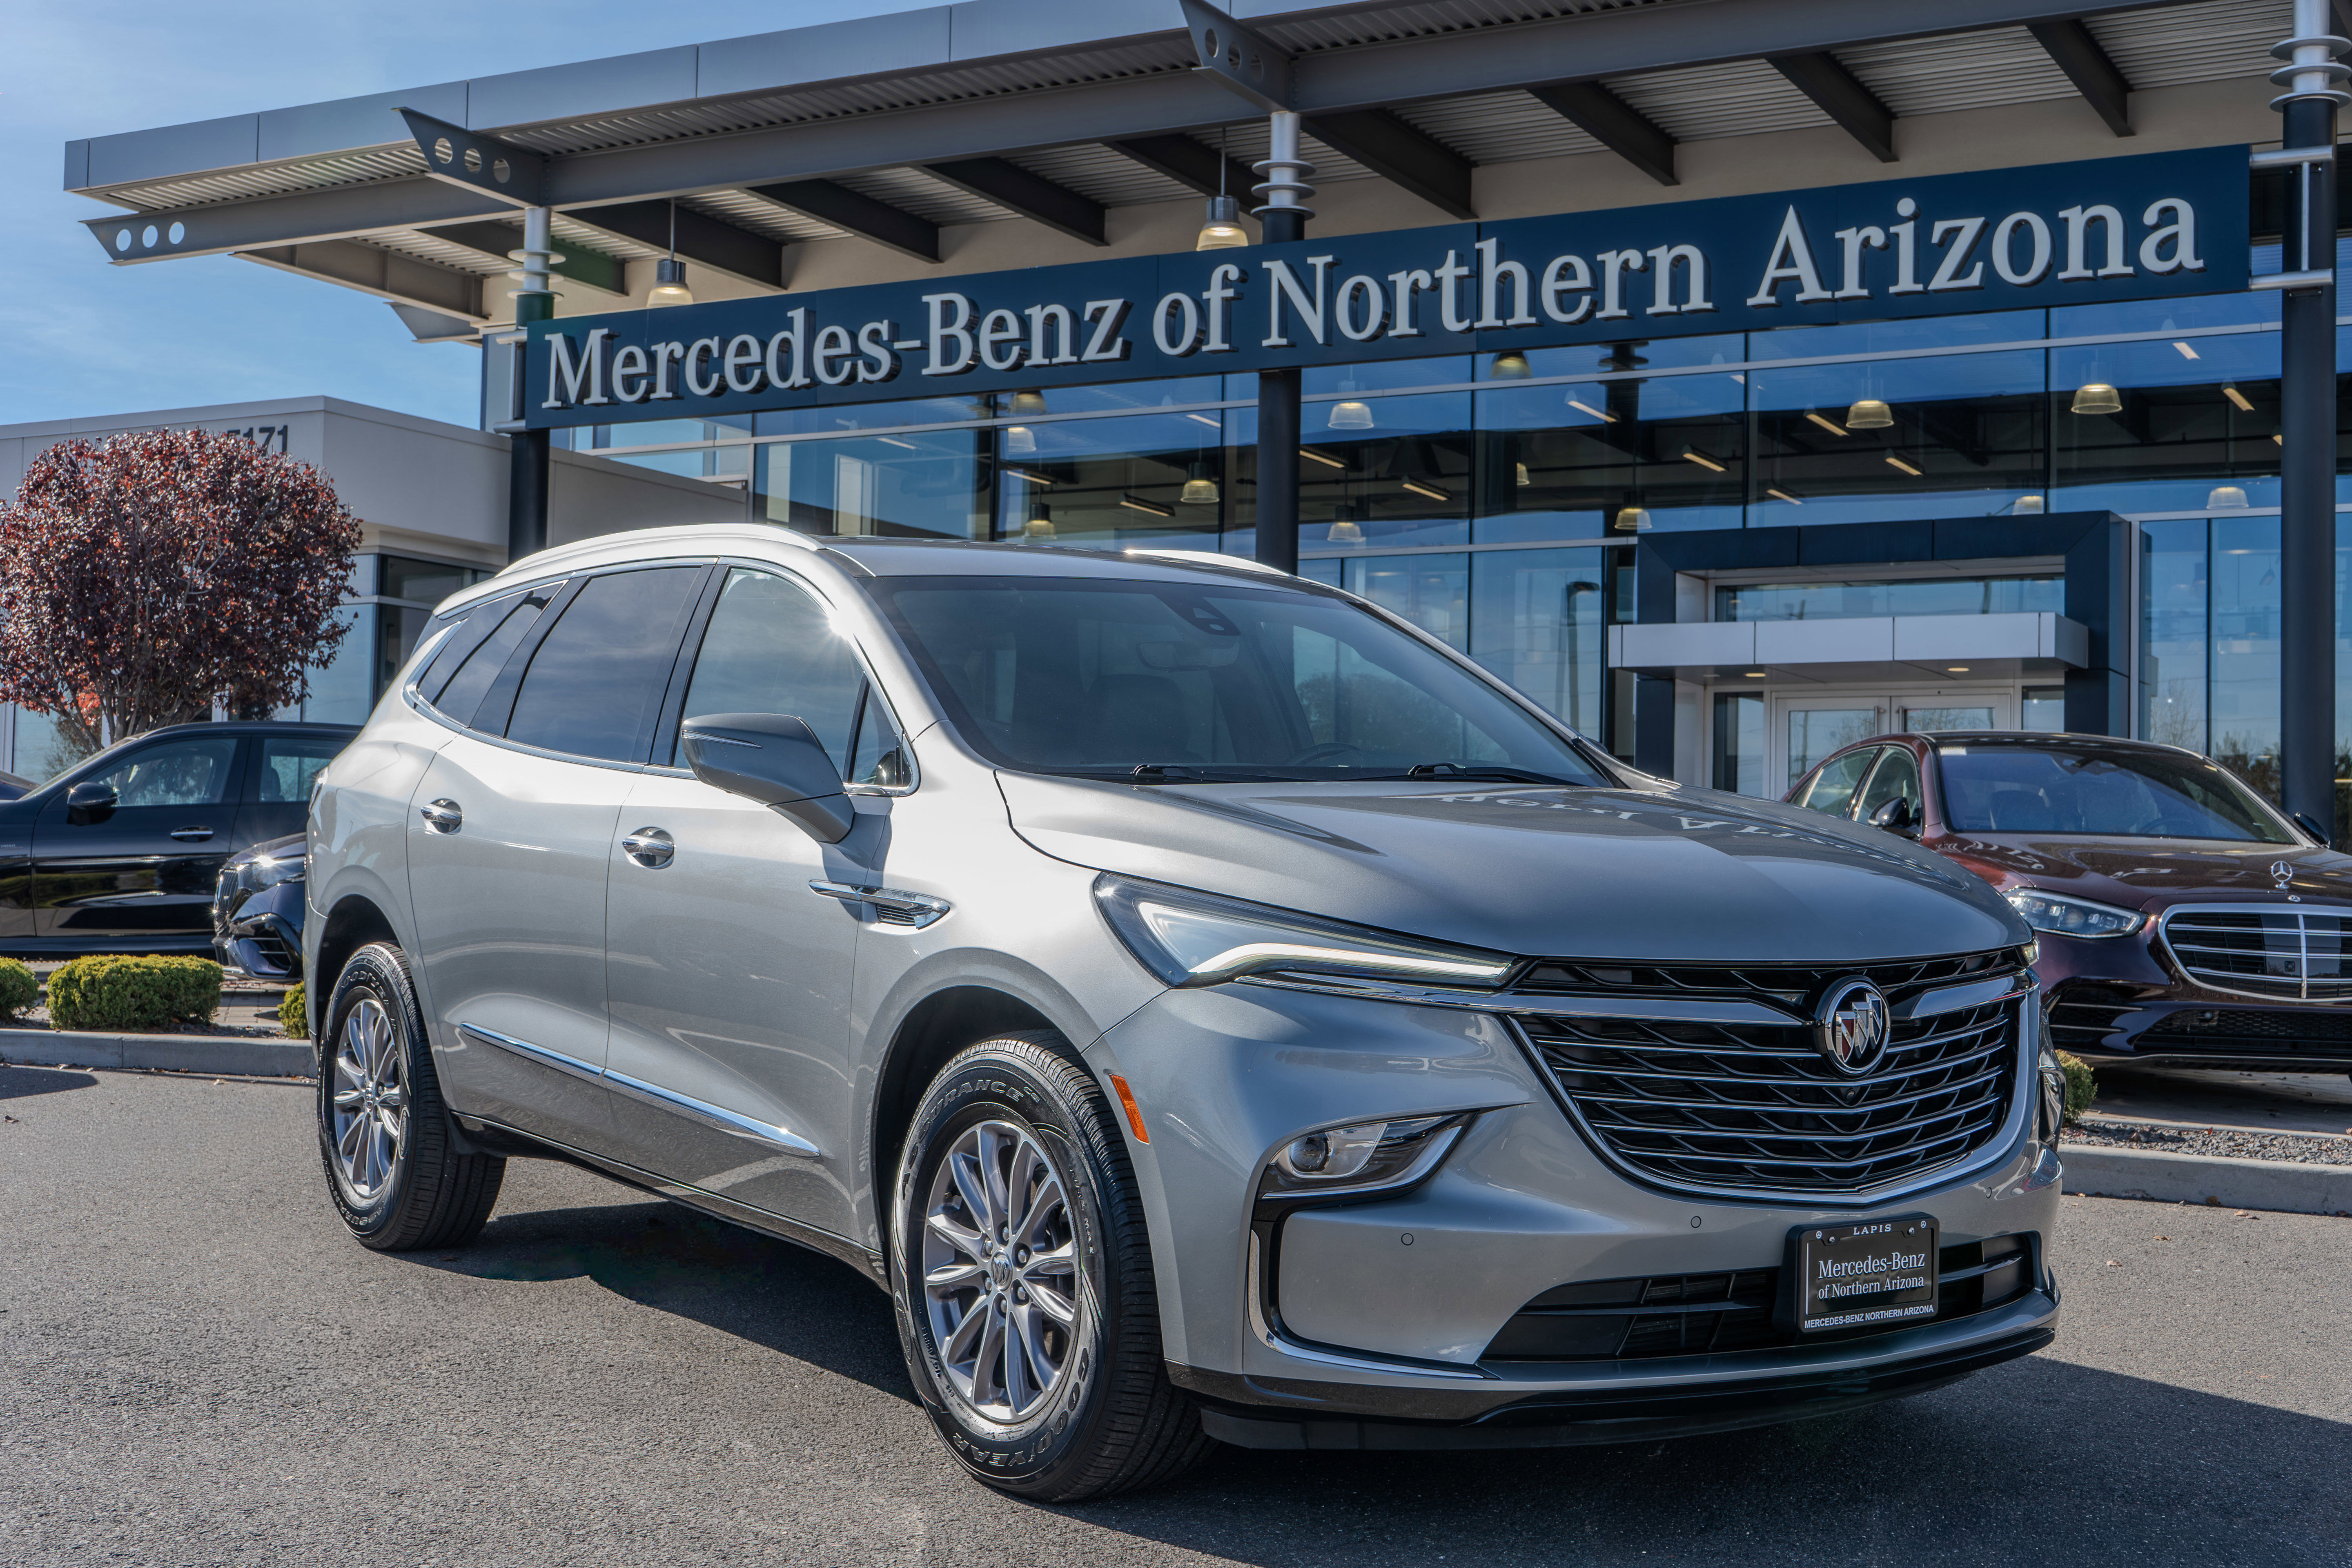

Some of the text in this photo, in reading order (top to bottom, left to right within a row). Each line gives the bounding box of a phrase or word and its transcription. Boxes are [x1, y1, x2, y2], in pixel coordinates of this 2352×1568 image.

[542, 198, 2206, 408] Mercedes-Benz of Northern Arizona
[902, 1079, 1024, 1201] ASSURANCE
[1853, 1224, 1891, 1235] LAPIS
[1818, 1252, 1925, 1279] Mercedes-Benz
[1818, 1276, 1924, 1299] of Northern Arizona
[1804, 1304, 1934, 1329] MERCEDES-BENZ NORTHERN ARIZONA
[953, 1348, 1088, 1466] GOODYEAR
